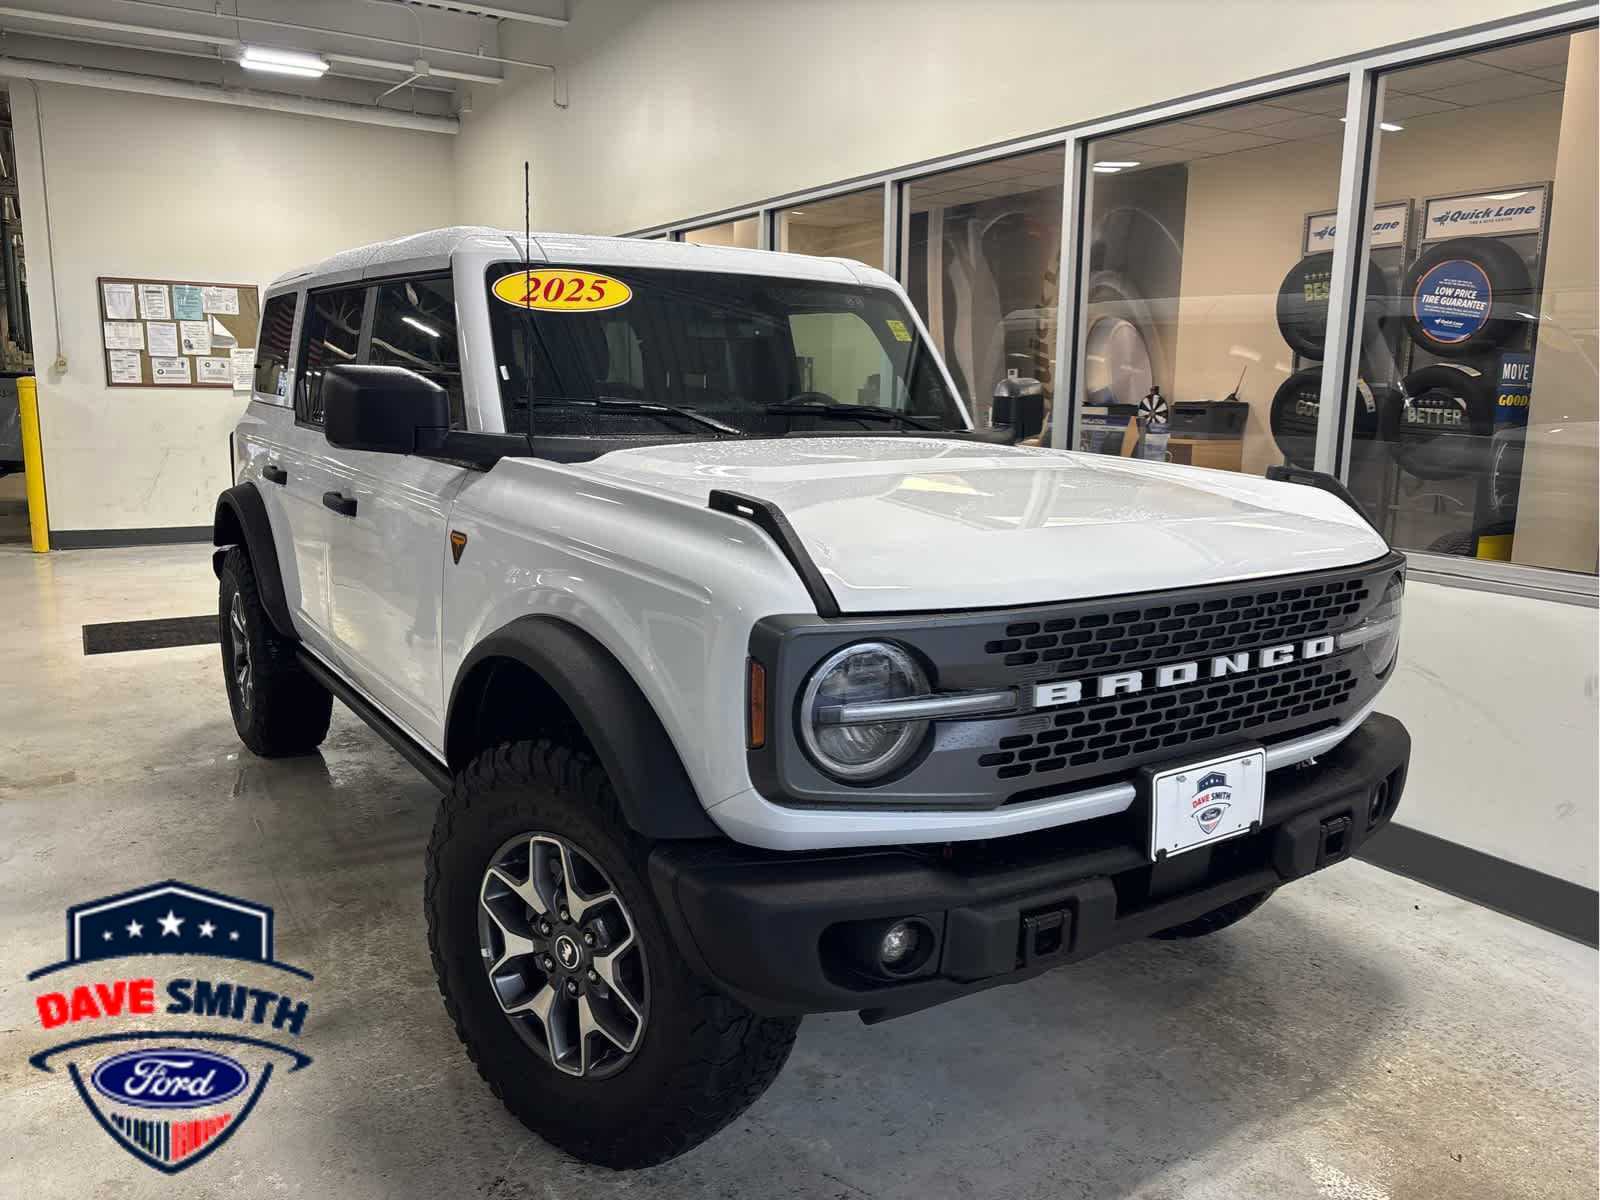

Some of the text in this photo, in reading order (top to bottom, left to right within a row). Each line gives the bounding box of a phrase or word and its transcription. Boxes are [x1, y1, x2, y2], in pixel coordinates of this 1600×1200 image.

[1450, 207, 1493, 222] Quick
[1494, 205, 1536, 217] Lane
[1372, 221, 1400, 231] ane
[519, 277, 608, 302] 2025
[1304, 281, 1331, 303] BES
[1434, 286, 1478, 299] LOW PRICE
[1422, 294, 1441, 304] TIRE
[1440, 297, 1488, 311] GUARANTEE
[1502, 363, 1530, 380] MOVE
[1498, 394, 1530, 407] GOOD
[1407, 407, 1462, 425] BETTER
[1033, 635, 1335, 708] BRONCO
[1211, 792, 1231, 801] SMITH
